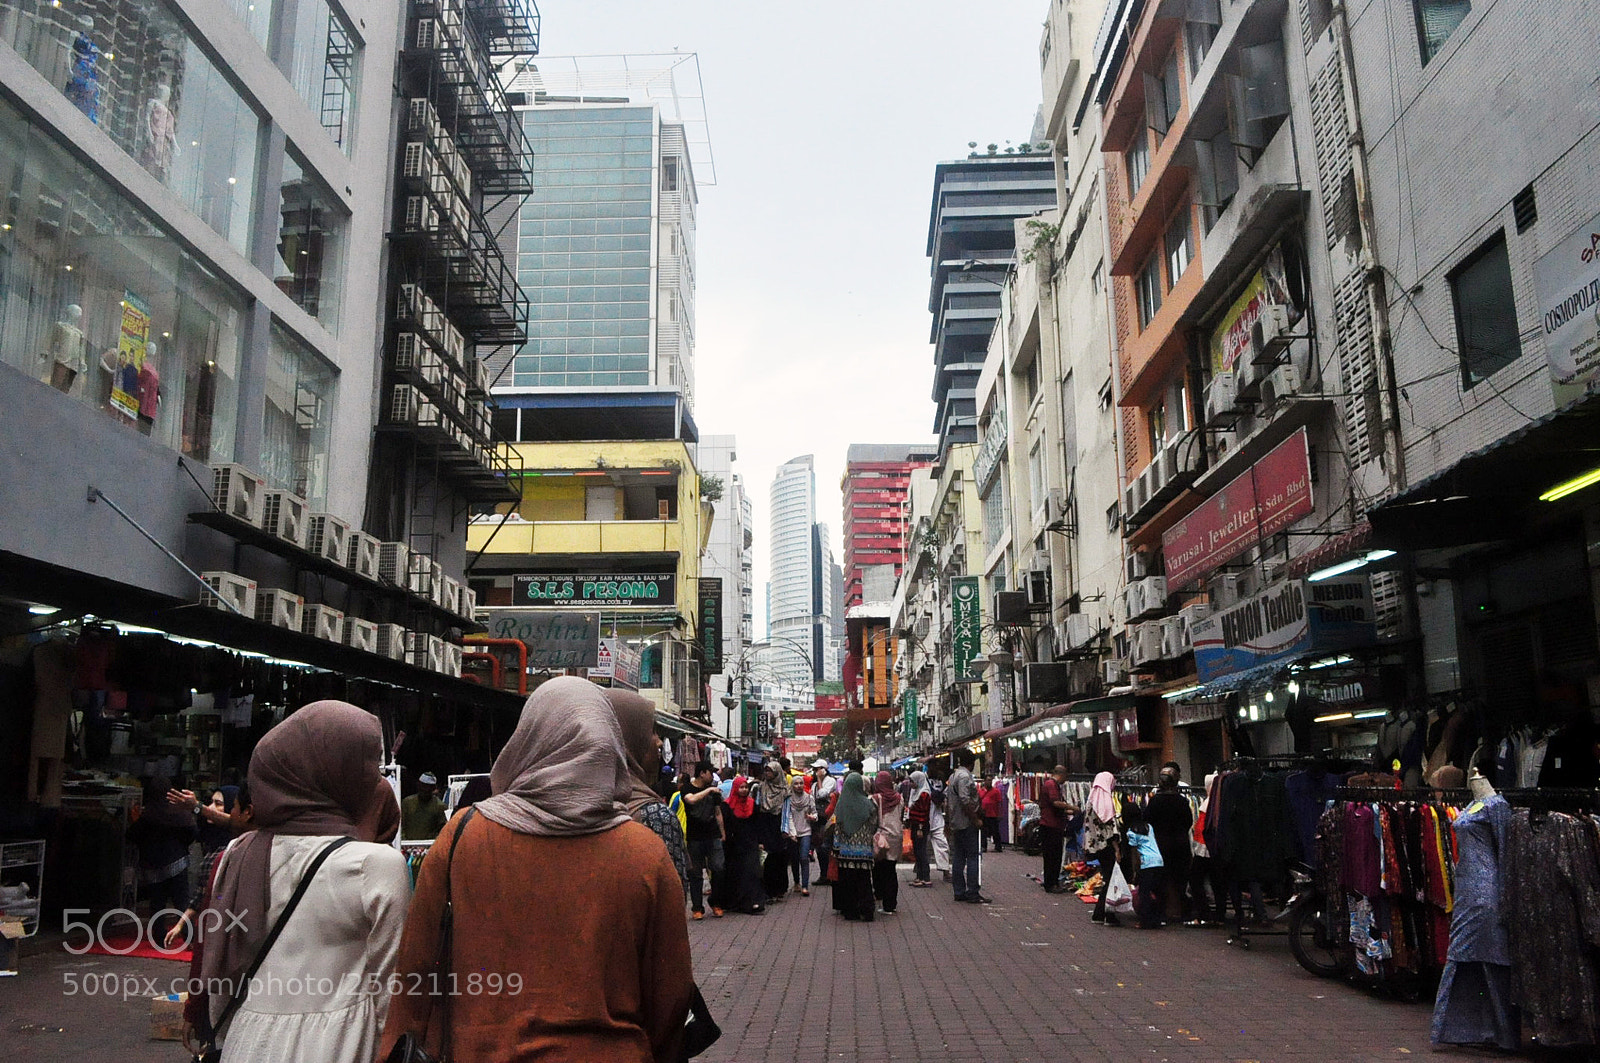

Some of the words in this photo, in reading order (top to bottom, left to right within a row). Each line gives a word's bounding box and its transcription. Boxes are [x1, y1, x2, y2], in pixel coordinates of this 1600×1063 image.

[1167, 535, 1204, 572] Varusai
[1207, 502, 1263, 552] Jewellers
[1265, 493, 1284, 511] Sdn
[1286, 474, 1306, 496] Bhd
[527, 581, 575, 599] S.E.S
[582, 581, 659, 599] PESONA
[1312, 583, 1363, 602] MEMON
[553, 598, 633, 606] www.sespesona.com.my
[495, 614, 590, 641] Roshni
[1220, 600, 1263, 650] MEMON
[1261, 582, 1304, 634] Textile
